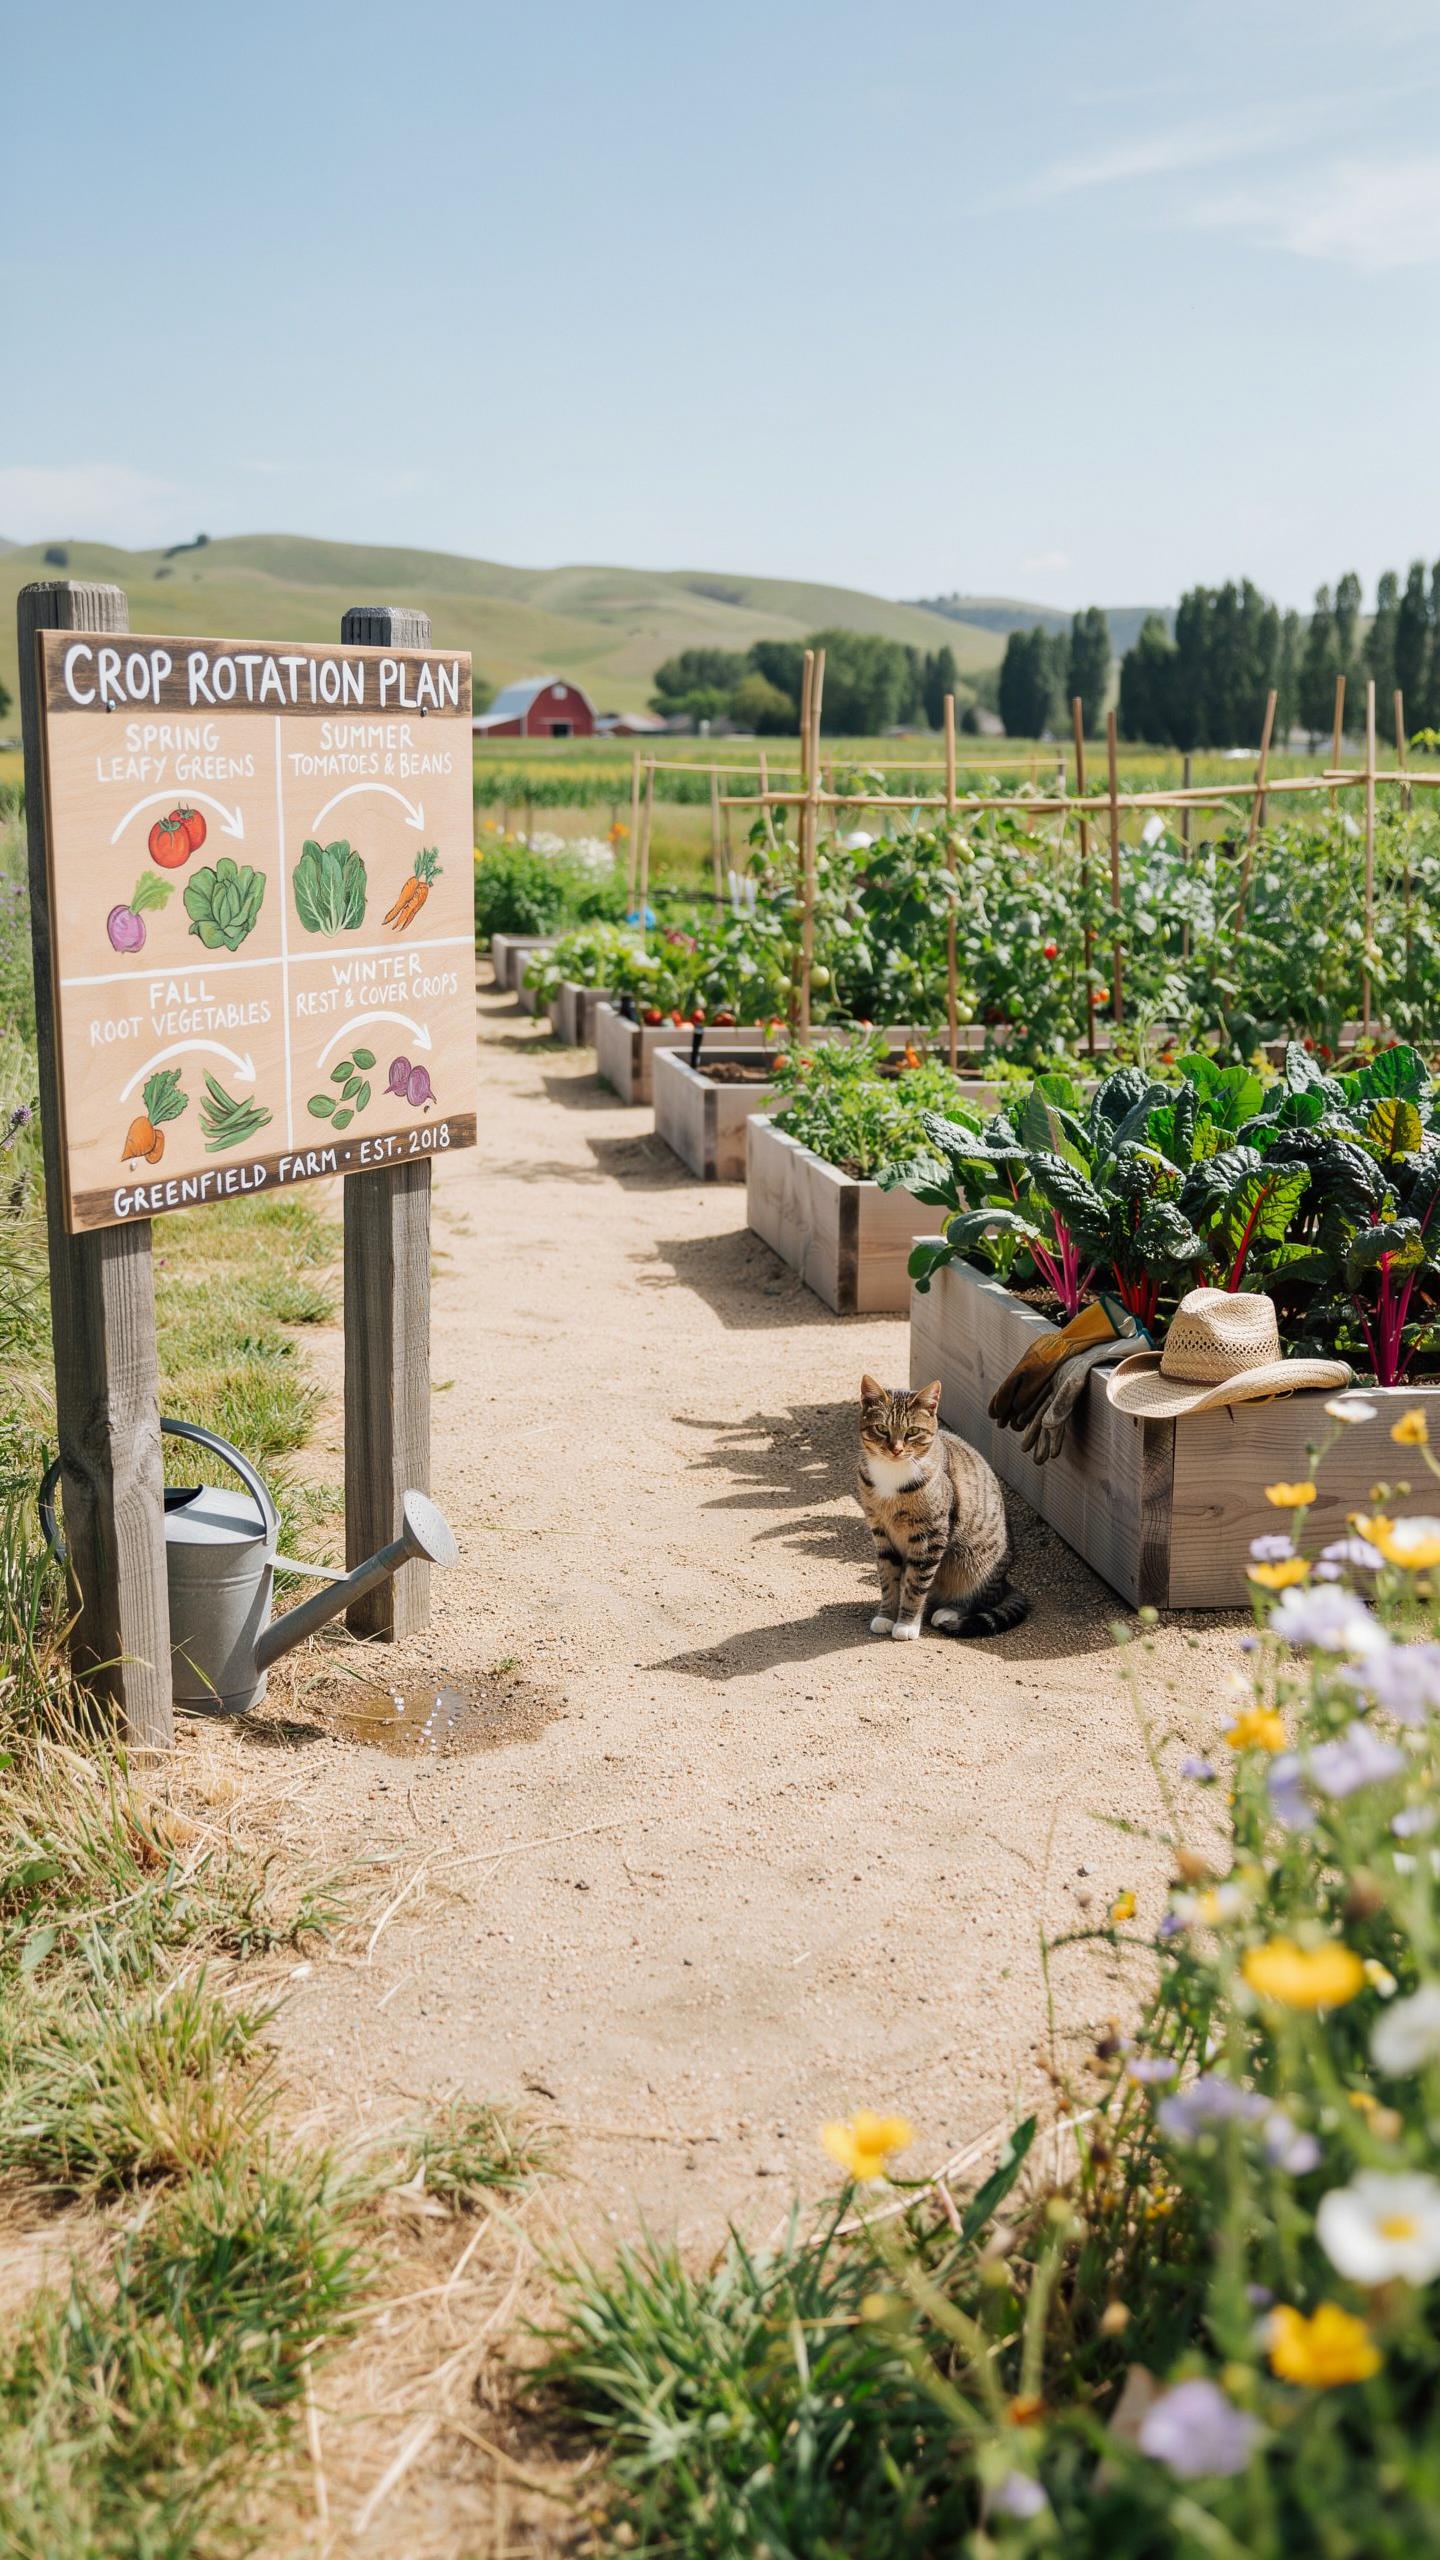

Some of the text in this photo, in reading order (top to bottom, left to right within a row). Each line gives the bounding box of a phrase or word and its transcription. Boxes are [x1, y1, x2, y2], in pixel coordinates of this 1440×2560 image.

[65, 644, 459, 708] CROP ROTATION PLAN
[125, 723, 219, 752] SPRING
[320, 722, 413, 751] SUMMER
[97, 753, 255, 782] LEAFY GREENS
[288, 752, 452, 777] TOMATOES & BEANS
[332, 953, 422, 986] WINTER
[150, 980, 215, 1009] FALL
[296, 973, 458, 1017] REST & COVER CROPS
[91, 1001, 271, 1046] ROOT VEGETABLES
[114, 1124, 450, 1217] GREENFIELD FARM EST. 2018
